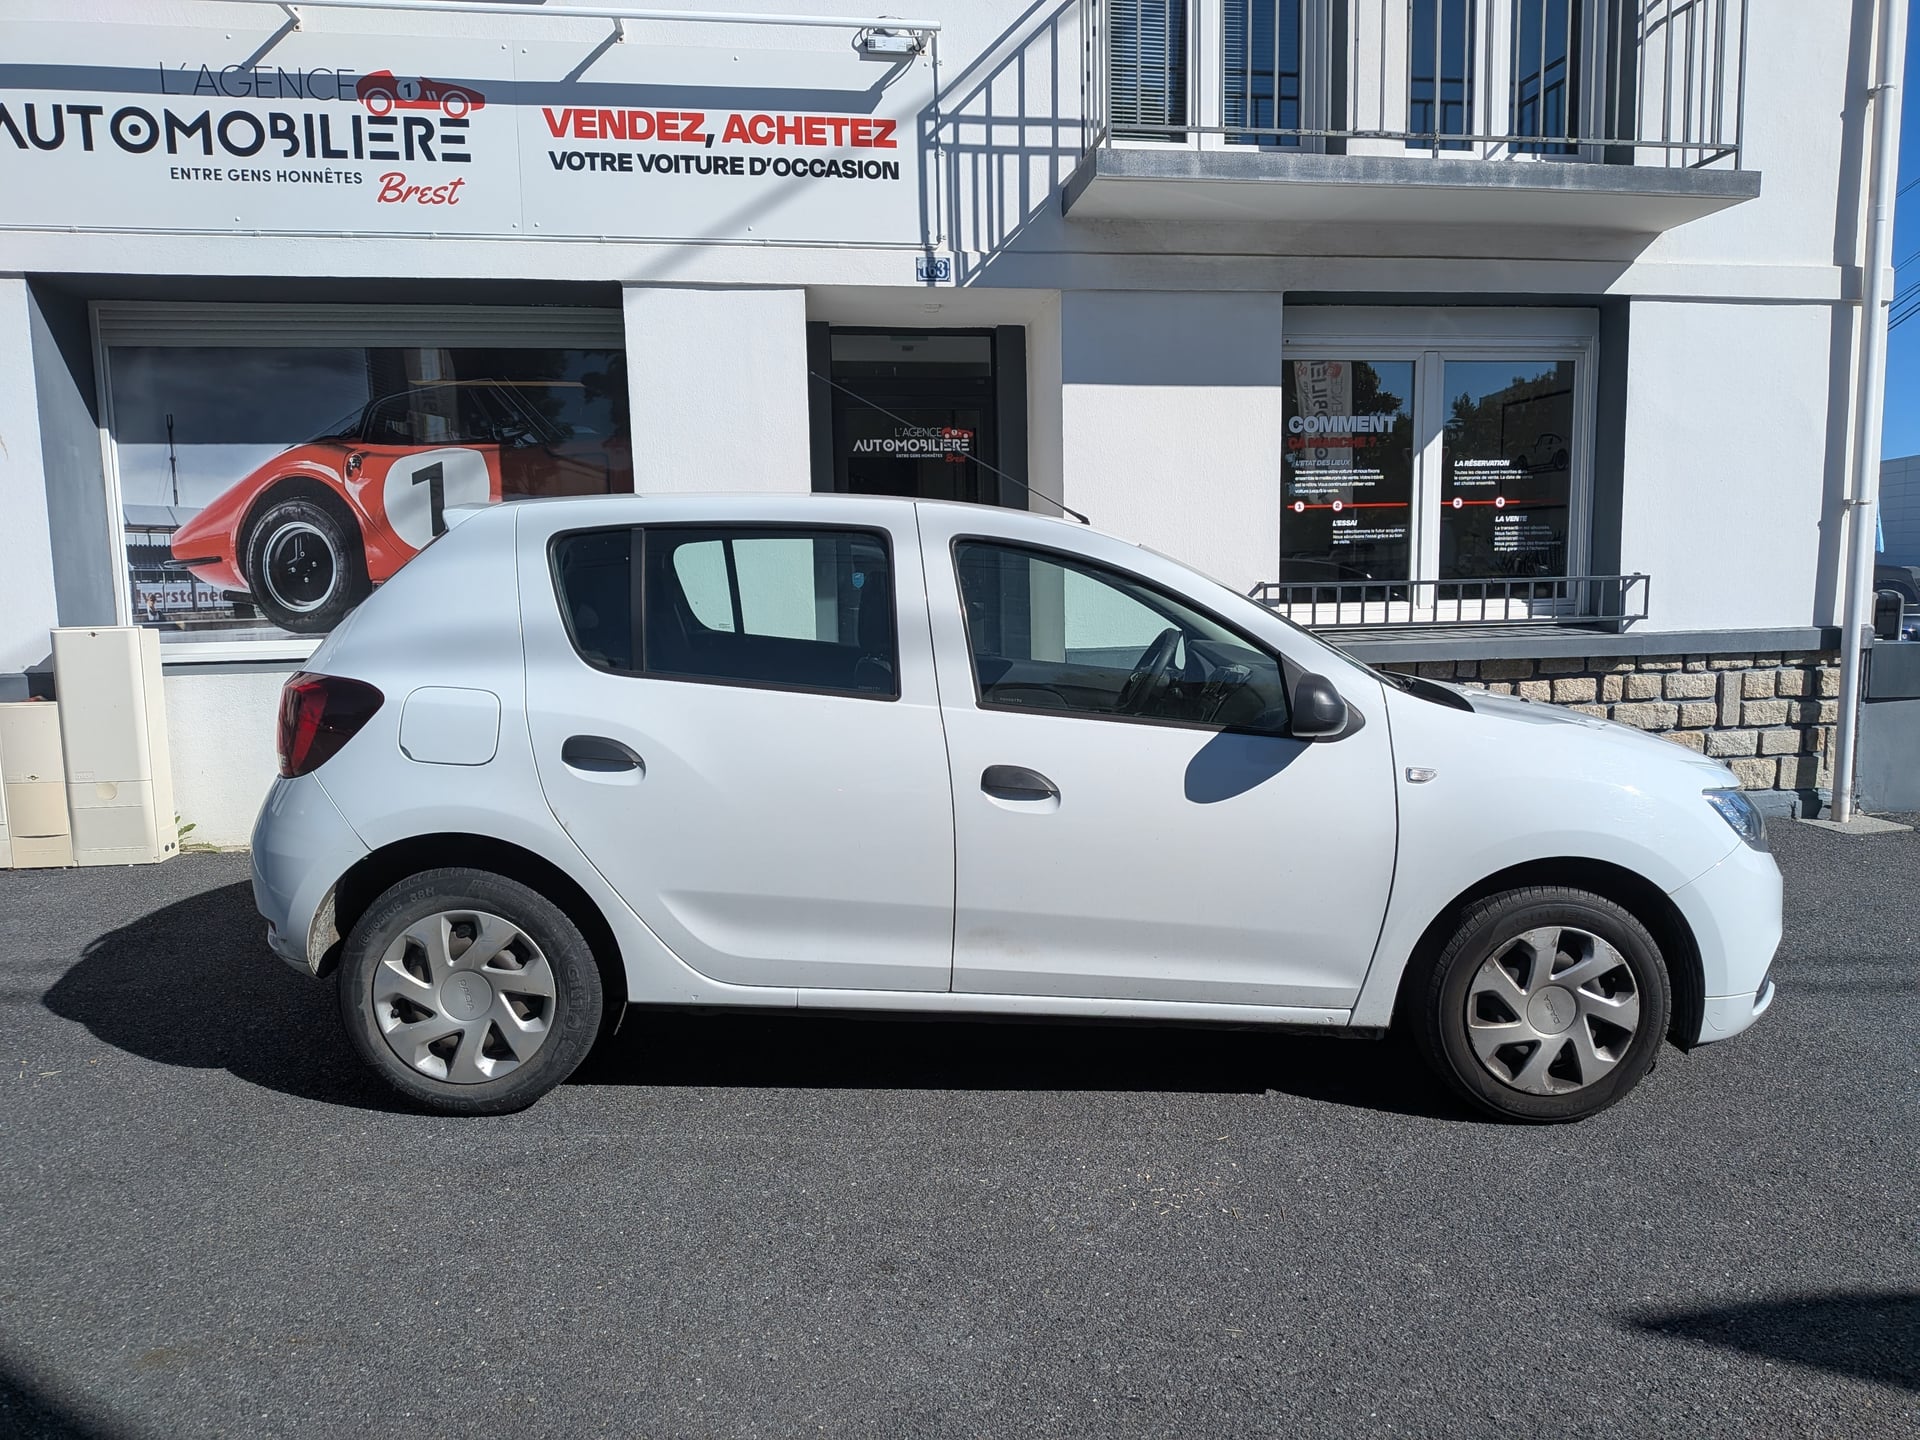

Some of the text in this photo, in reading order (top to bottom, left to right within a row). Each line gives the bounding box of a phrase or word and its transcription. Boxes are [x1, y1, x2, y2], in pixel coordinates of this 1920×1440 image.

[160, 61, 357, 101] L'AGENCE
[403, 83, 413, 98] 1
[542, 108, 897, 149] VENDEZ, ACHETEZ
[548, 151, 900, 180] VOTRE VOITURE D'OCCASION
[170, 167, 362, 184] ENTRE GENS HONNÊTES
[376, 172, 465, 205] Brest
[921, 261, 946, 278] 163
[895, 427, 942, 437] L'AGENCE
[1288, 416, 1397, 433] COMMENT
[1464, 459, 1510, 467] RÉSERVATION
[411, 461, 449, 537] 1
